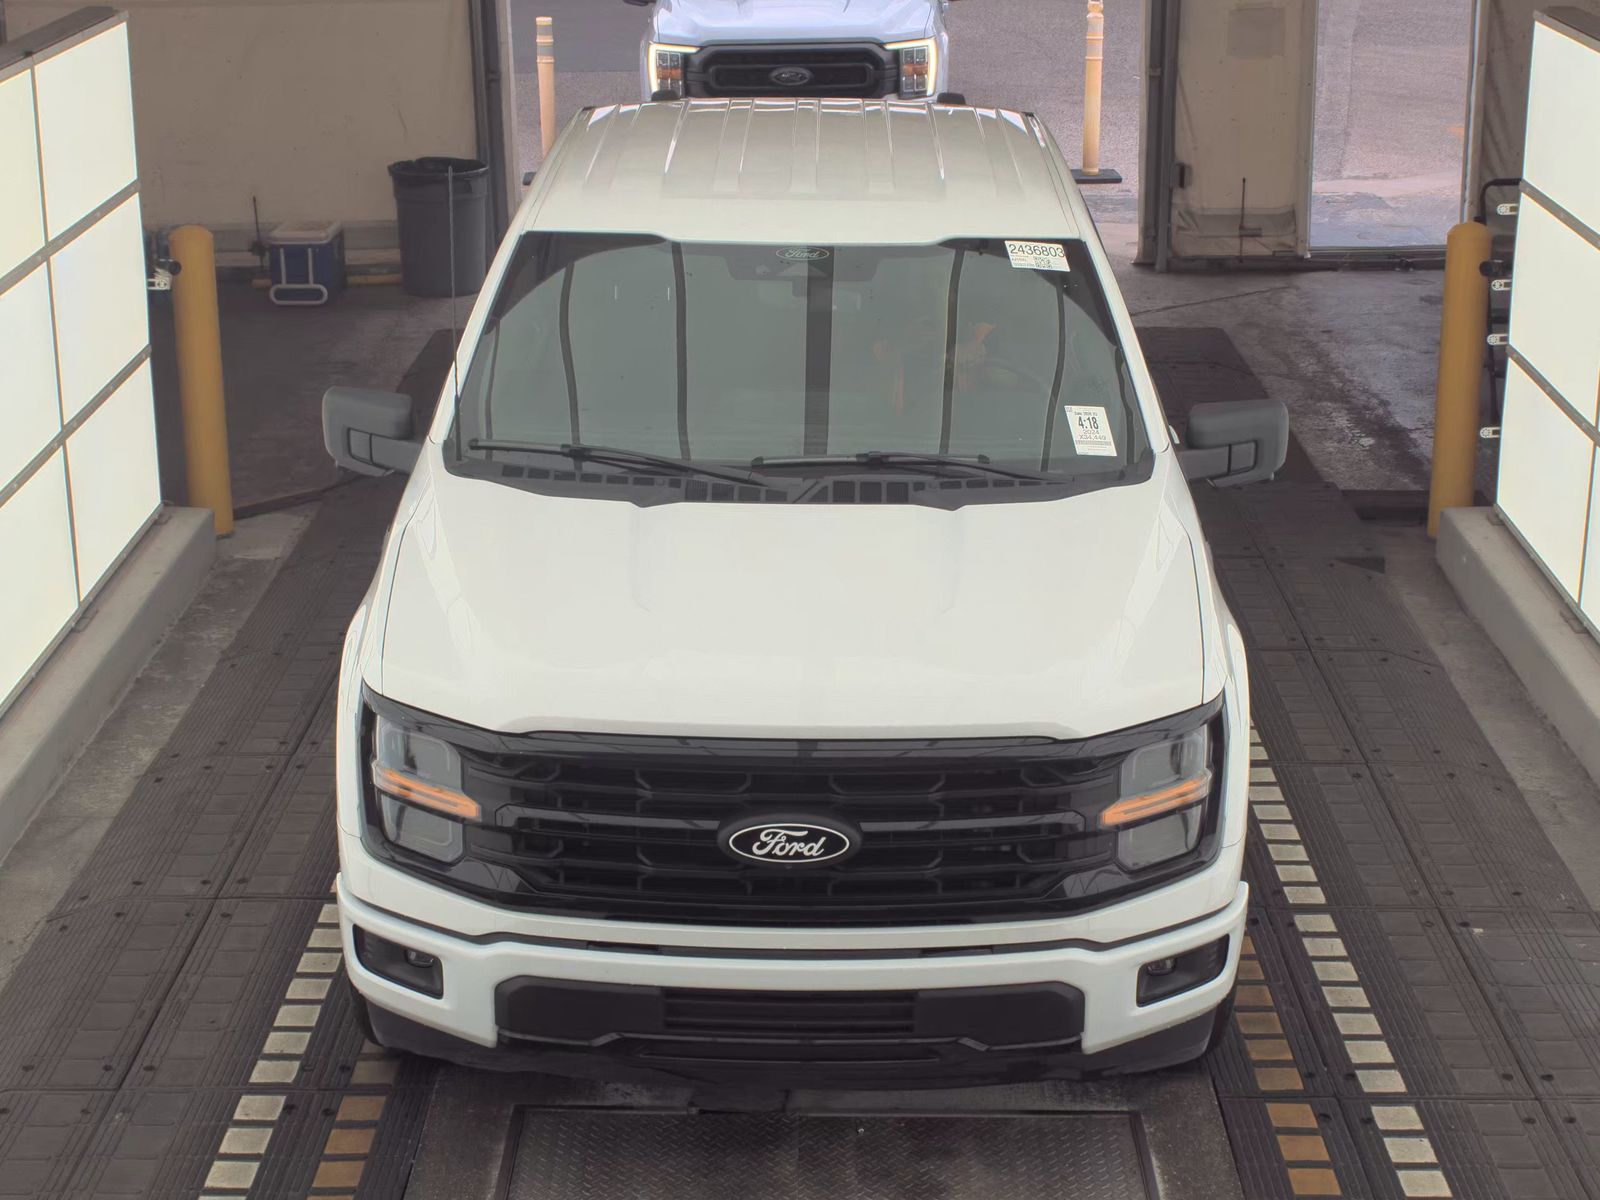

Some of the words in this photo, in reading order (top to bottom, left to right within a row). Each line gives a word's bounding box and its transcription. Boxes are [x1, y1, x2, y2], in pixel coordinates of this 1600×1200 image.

[1008, 243, 1065, 258] 2436803
[1078, 416, 1099, 430] 4:18
[752, 828, 826, 856] Ford
